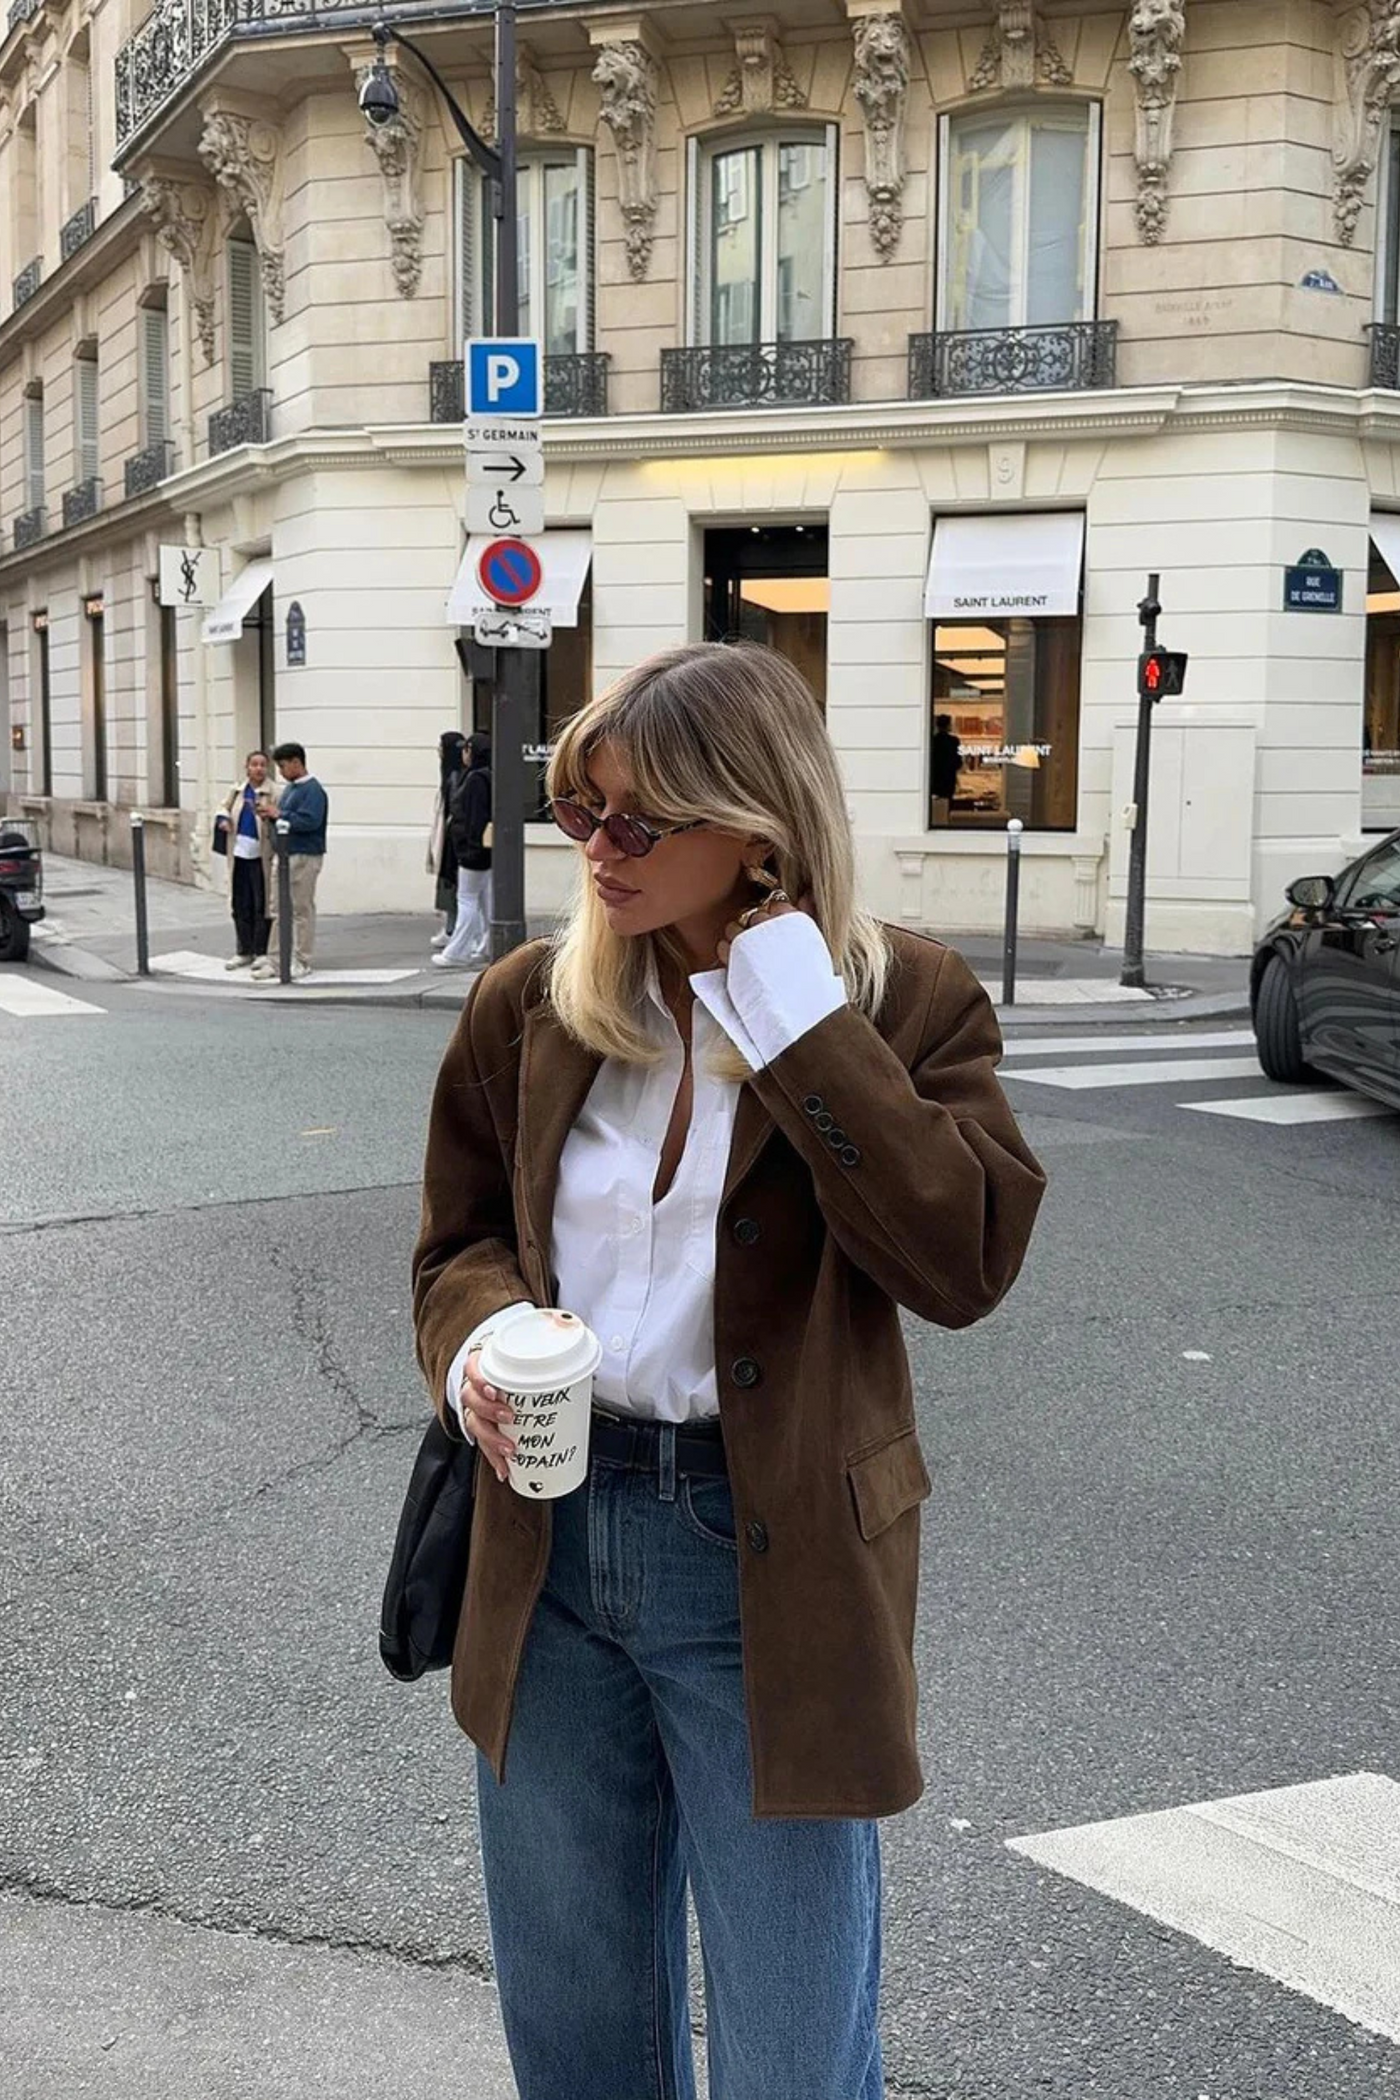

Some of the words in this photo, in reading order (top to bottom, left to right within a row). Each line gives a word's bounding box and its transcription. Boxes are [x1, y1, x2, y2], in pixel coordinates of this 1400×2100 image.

[487, 354, 520, 402] P
[482, 429, 538, 441] GERMAIN
[953, 597, 988, 608] SAINT
[991, 595, 1048, 607] LAURENT
[957, 745, 991, 756] SAINT
[993, 744, 1052, 756] LAUNT
[505, 1391, 526, 1409] TU
[532, 1387, 572, 1408] VEUX
[518, 1432, 556, 1449] MON
